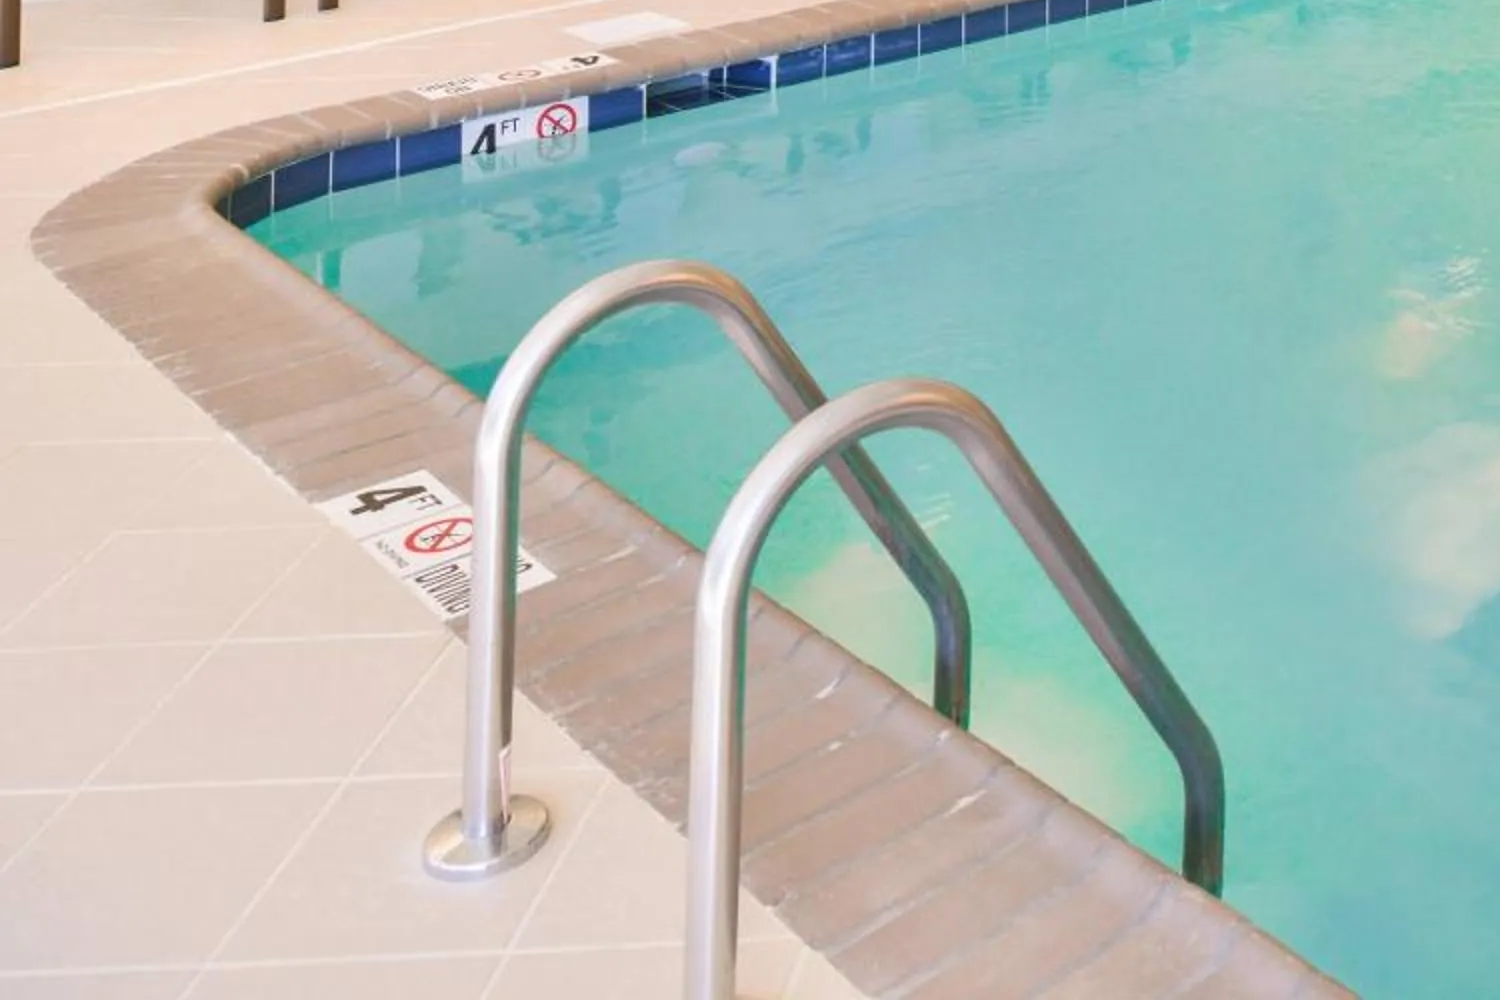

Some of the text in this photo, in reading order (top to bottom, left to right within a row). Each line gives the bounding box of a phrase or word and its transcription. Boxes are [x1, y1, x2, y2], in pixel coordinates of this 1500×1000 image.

[470, 117, 520, 155] 4 FT
[350, 485, 427, 516] 4
